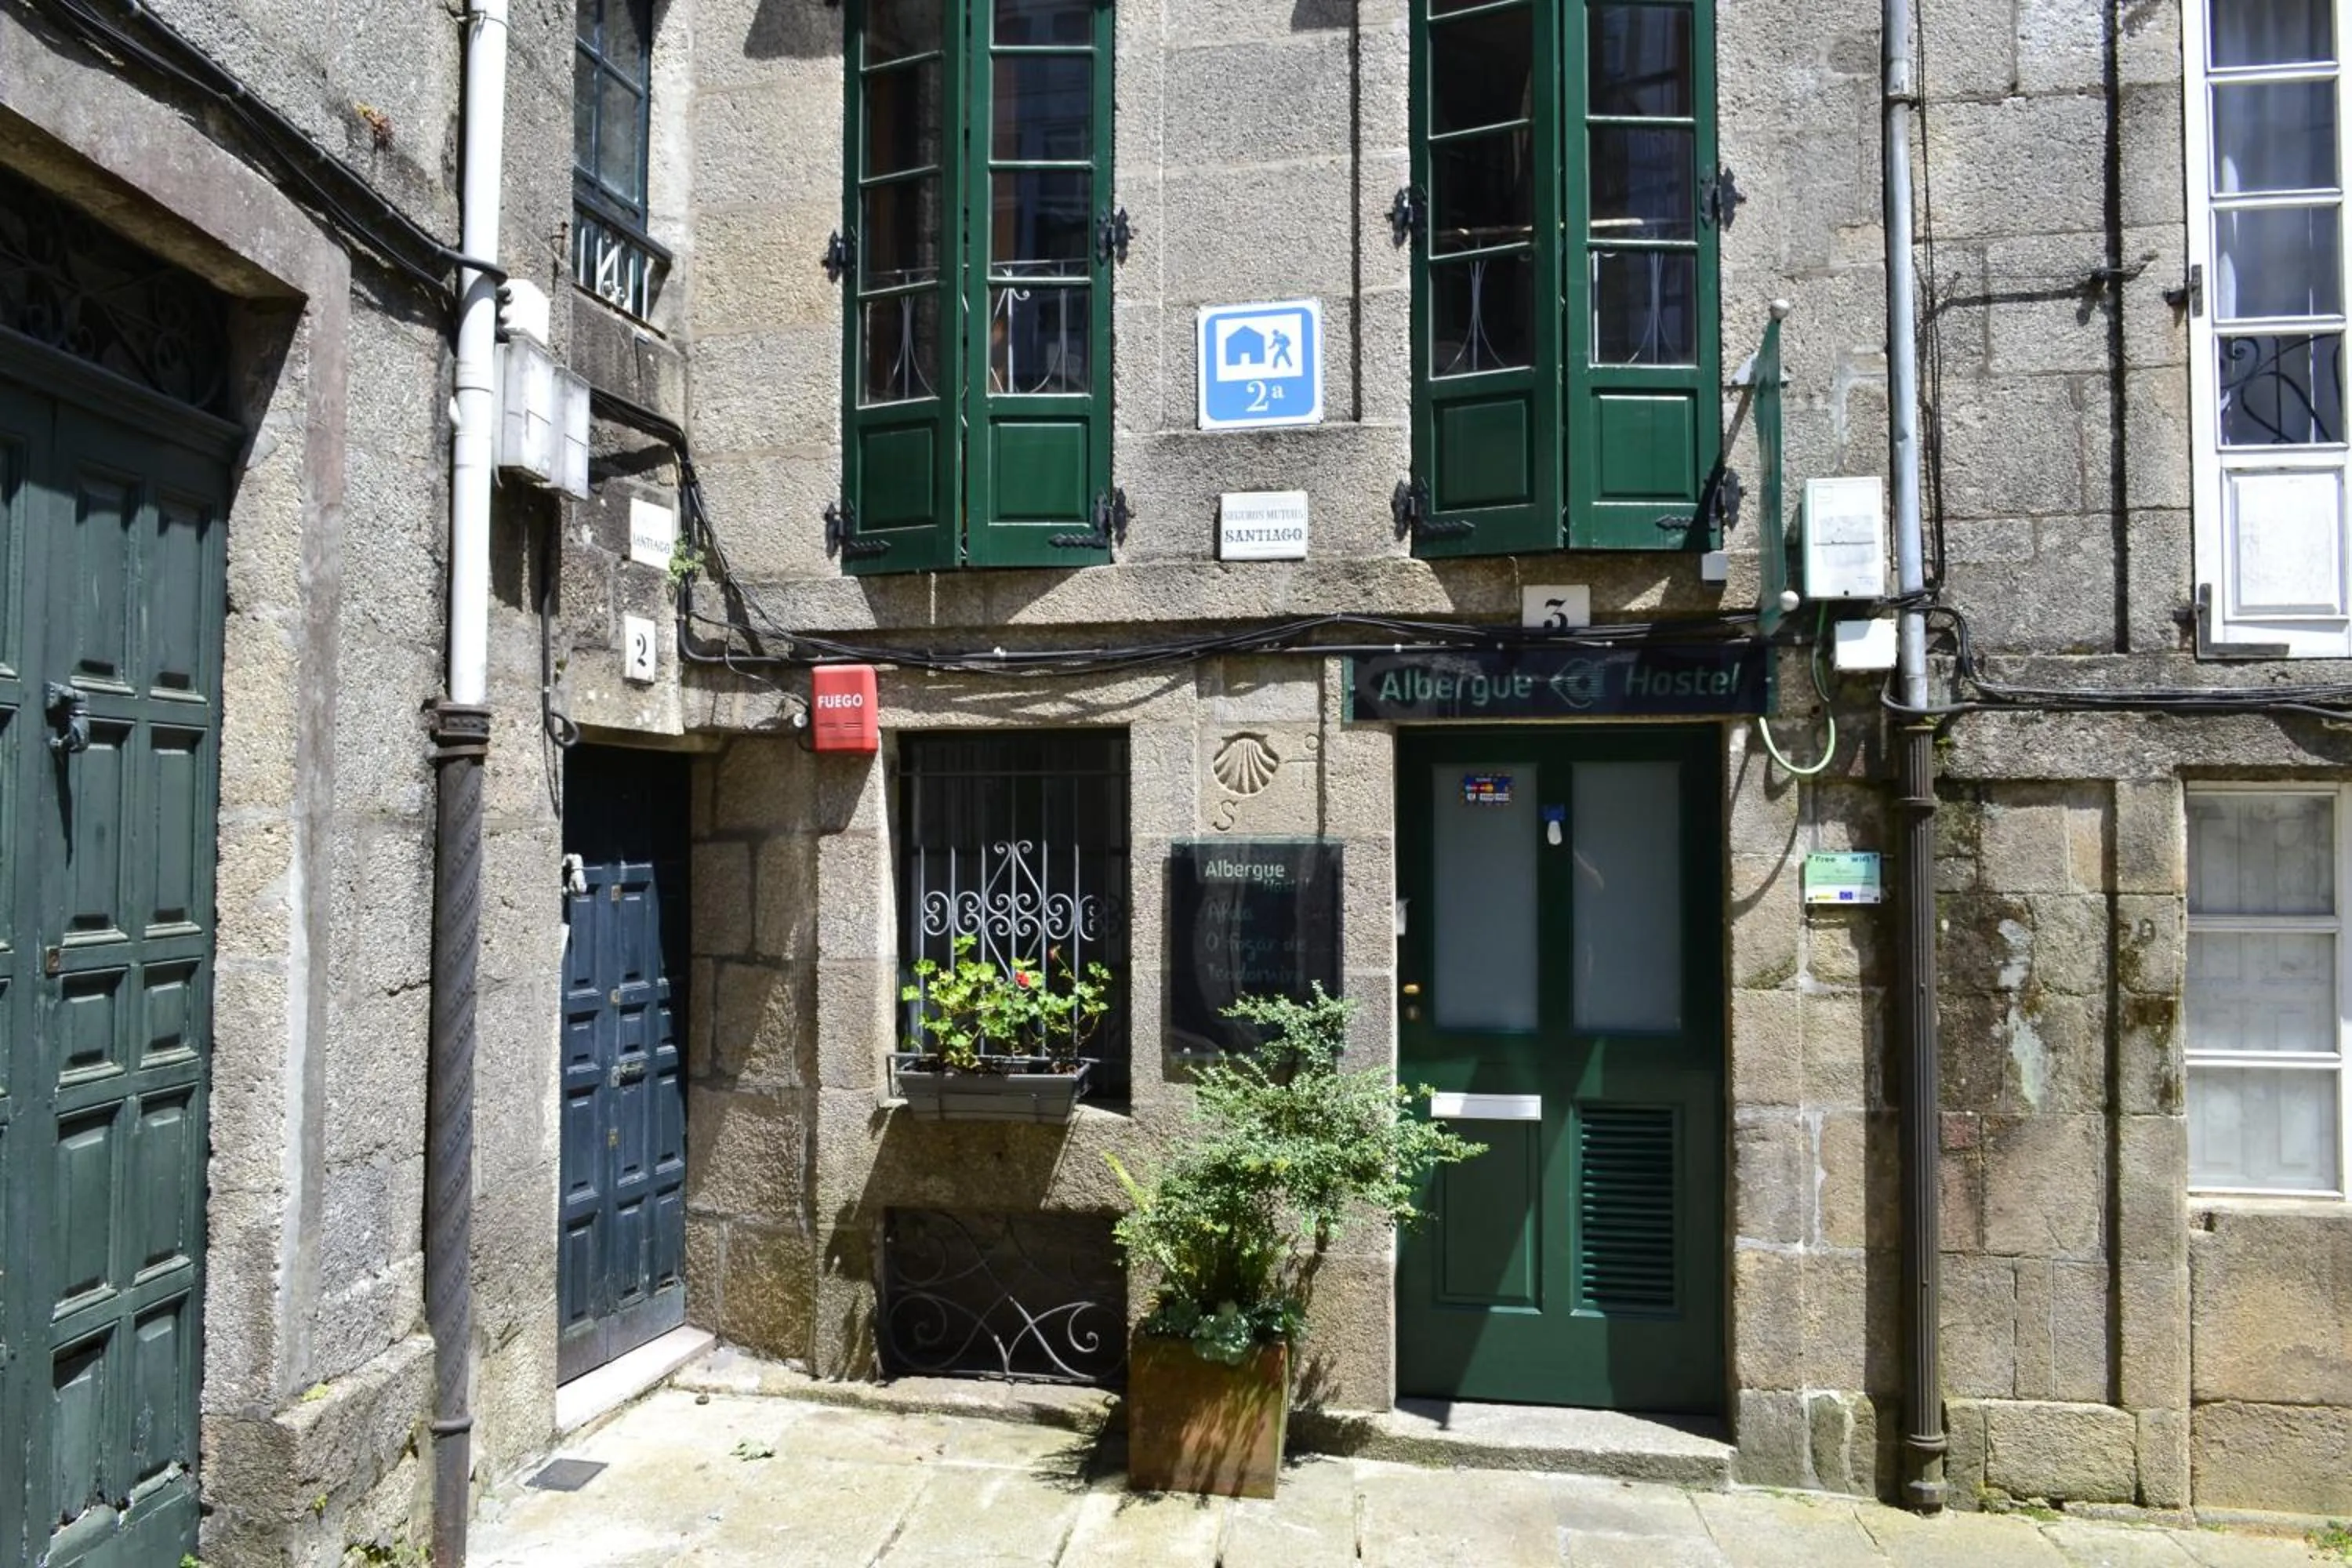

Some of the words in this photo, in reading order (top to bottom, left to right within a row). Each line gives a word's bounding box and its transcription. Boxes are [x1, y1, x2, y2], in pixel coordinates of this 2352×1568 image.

[633, 532, 670, 554] SANTIAGO
[1225, 528, 1303, 543] SANTIAGO
[1543, 598, 1568, 633] 3
[636, 633, 647, 667] 2
[1378, 666, 1533, 706] Albergue
[1626, 661, 1741, 697] Hostel
[817, 693, 863, 709] FUEGO
[1205, 858, 1286, 881] Albergue
[1263, 877, 1310, 893] Hostl
